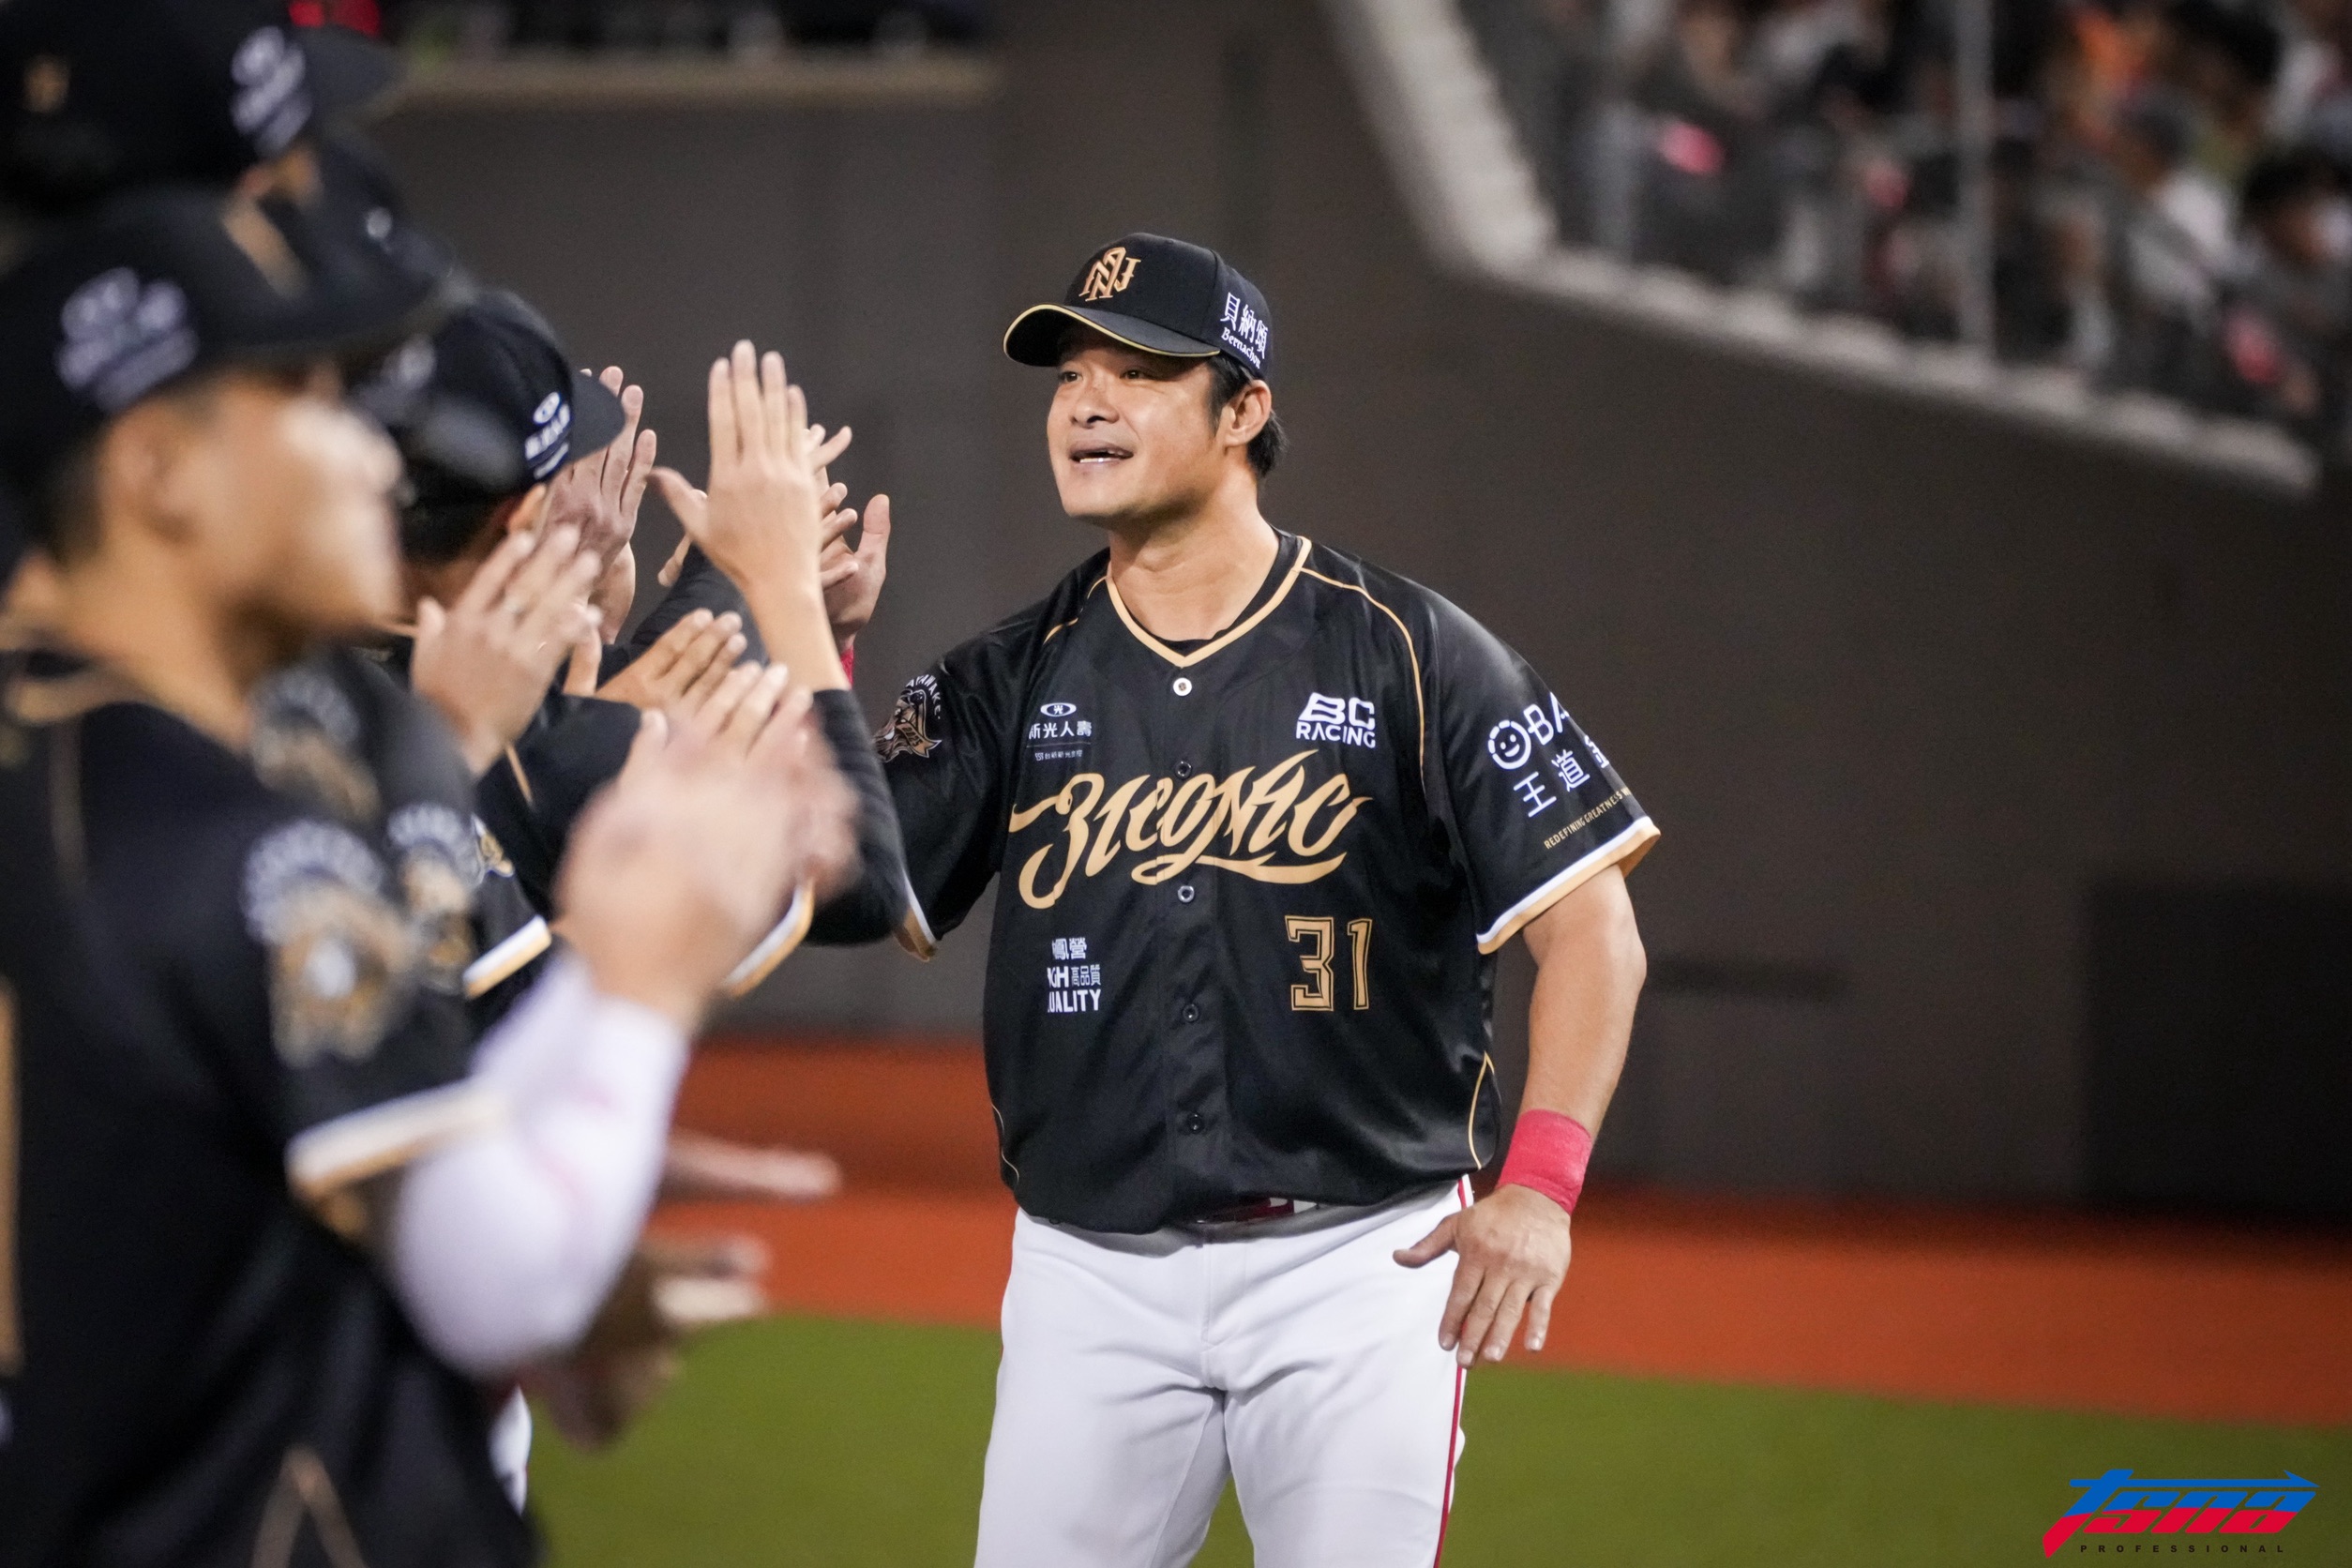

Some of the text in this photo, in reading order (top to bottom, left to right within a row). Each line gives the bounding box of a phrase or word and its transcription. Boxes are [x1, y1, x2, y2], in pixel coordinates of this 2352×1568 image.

[1221, 327, 1260, 369] Bernachon
[1298, 692, 1376, 731] BC
[1296, 721, 1376, 748] RACING
[1544, 818, 1585, 850] REDEFINING
[1584, 791, 1623, 823] GREATNESS
[1070, 964, 1101, 987] 高品質
[1285, 915, 1372, 1011] 31
[1048, 988, 1101, 1013] UALITY
